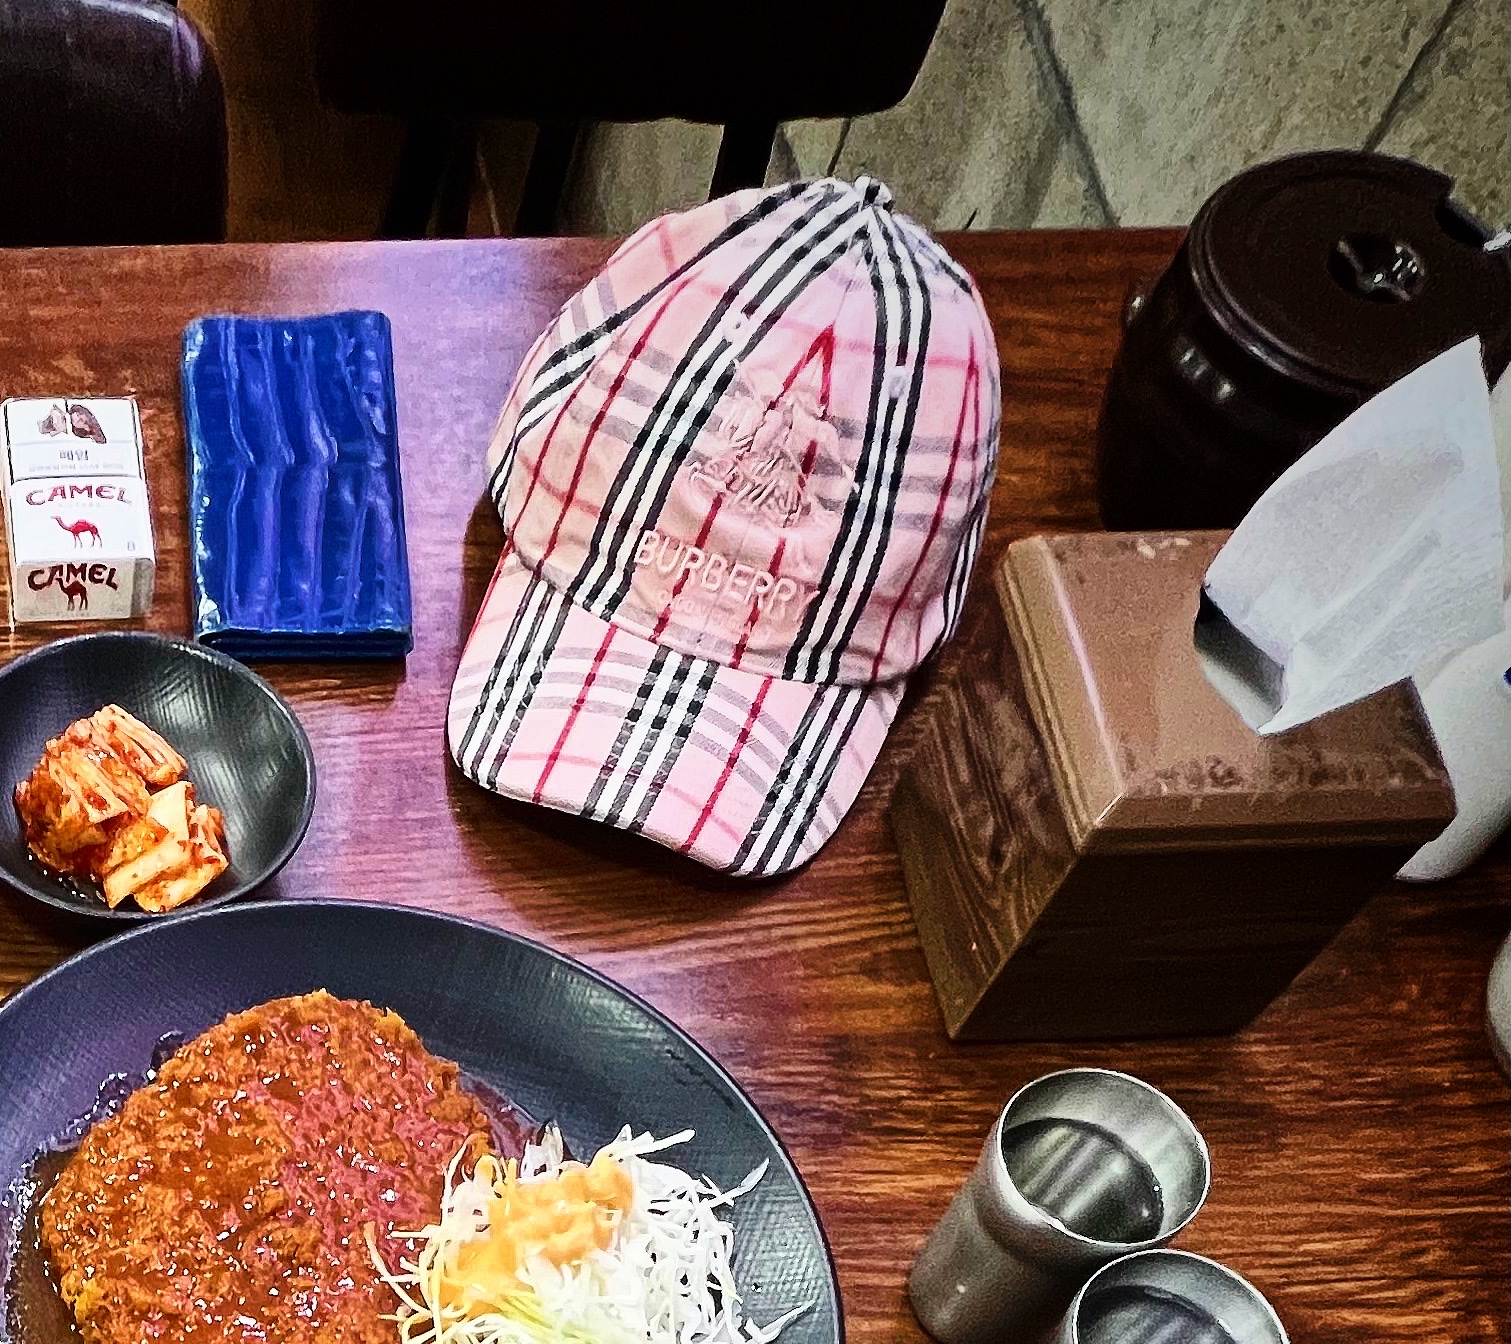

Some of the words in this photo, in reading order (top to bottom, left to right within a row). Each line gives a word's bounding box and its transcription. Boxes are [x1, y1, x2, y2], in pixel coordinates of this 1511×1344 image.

[25, 483, 133, 506] CAMEL
[27, 562, 119, 592] CAMEL
[633, 529, 821, 624] BURBERRY
